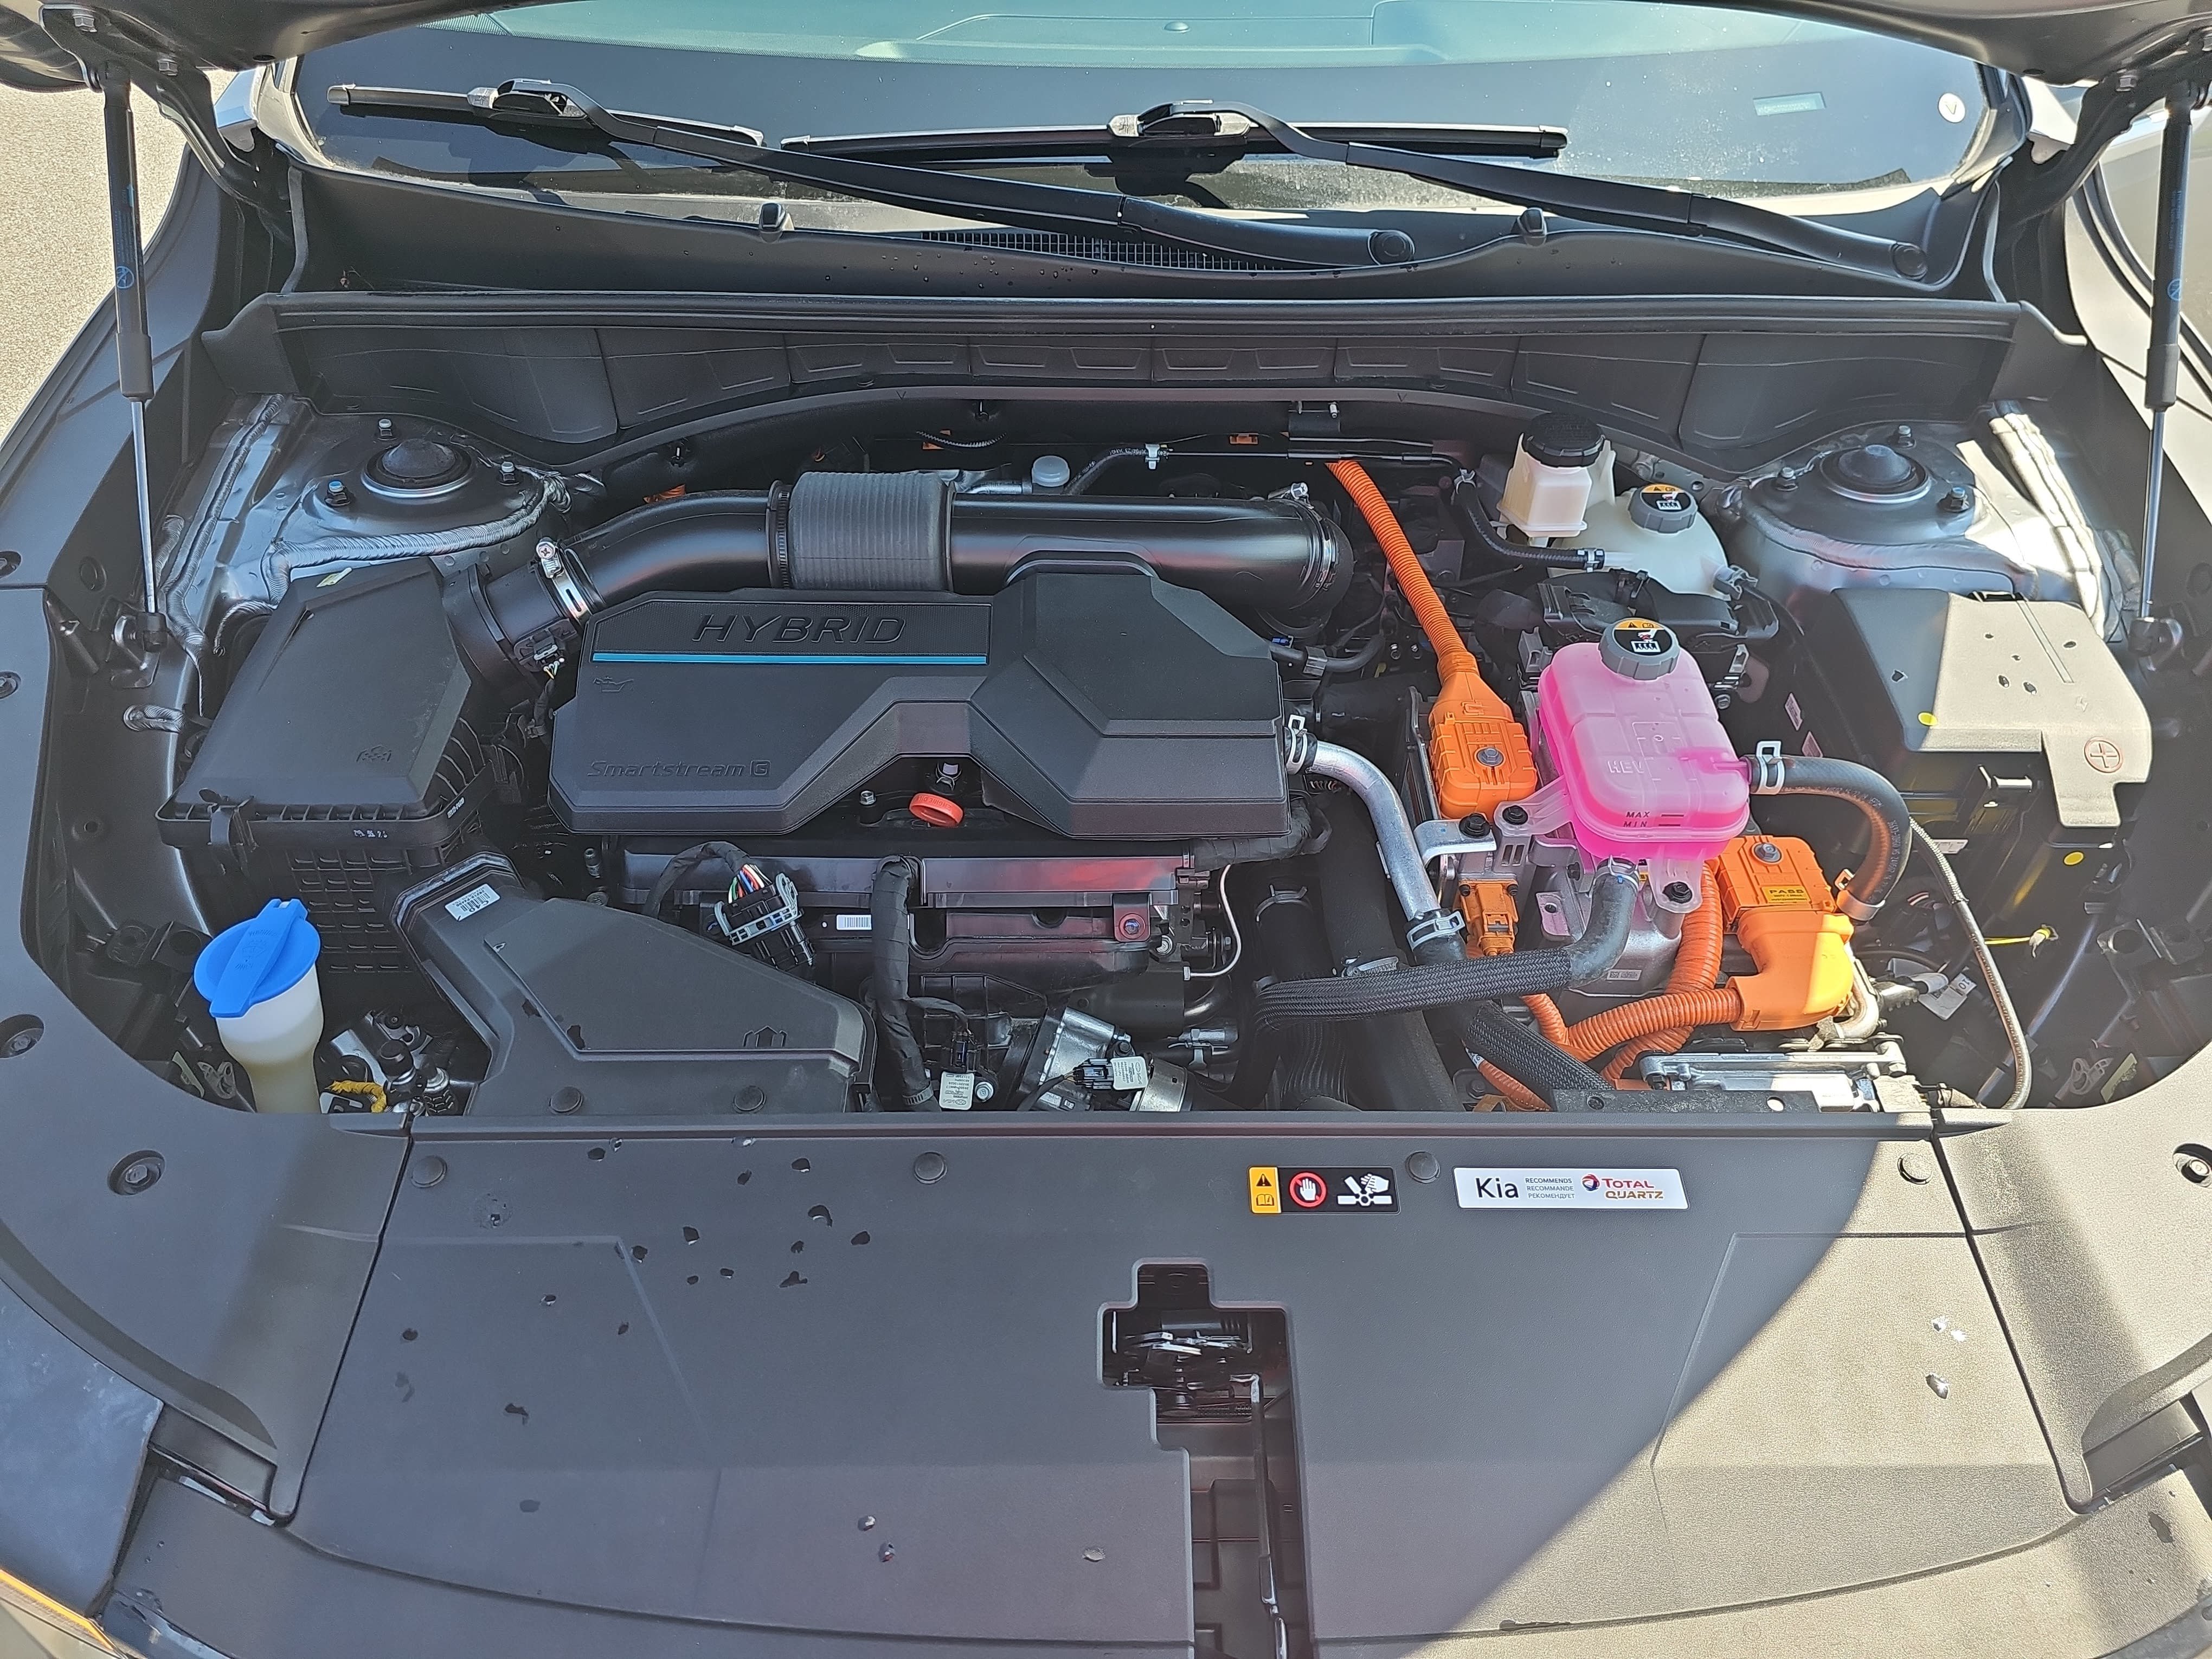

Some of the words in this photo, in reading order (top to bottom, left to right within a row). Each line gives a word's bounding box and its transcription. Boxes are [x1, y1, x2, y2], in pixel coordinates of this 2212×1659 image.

[691, 614, 906, 644] HYBRID
[587, 760, 746, 777] Smartstream
[1607, 760, 1644, 774] HEV
[1475, 1178, 1519, 1198] Kia
[1605, 1191, 1664, 1200] QUARTZ
